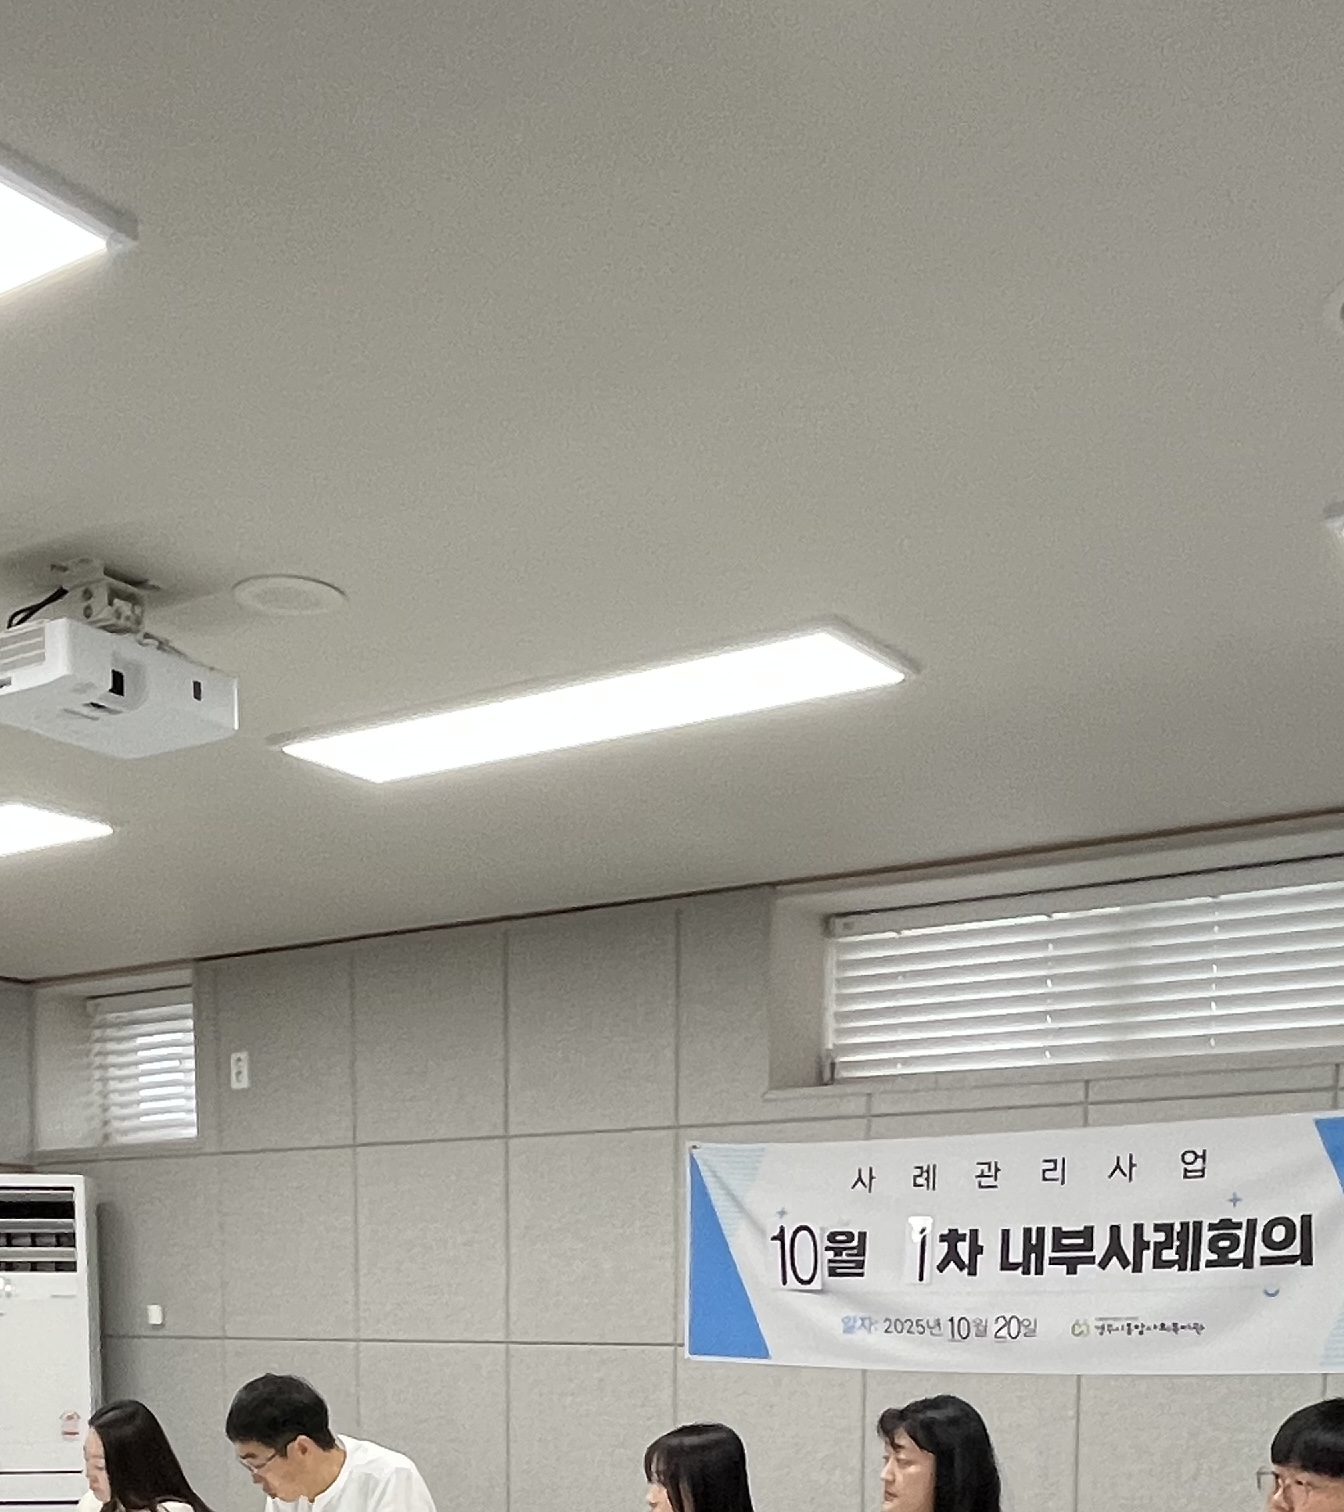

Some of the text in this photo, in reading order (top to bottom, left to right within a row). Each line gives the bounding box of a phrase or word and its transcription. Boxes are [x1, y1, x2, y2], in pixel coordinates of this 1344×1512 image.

[769, 1224, 868, 1287] 10월
[998, 1213, 1314, 1276] 내부사례회의
[882, 1316, 944, 1338] 2025년
[947, 1316, 989, 1341] 10월
[993, 1314, 1038, 1341] 20일
